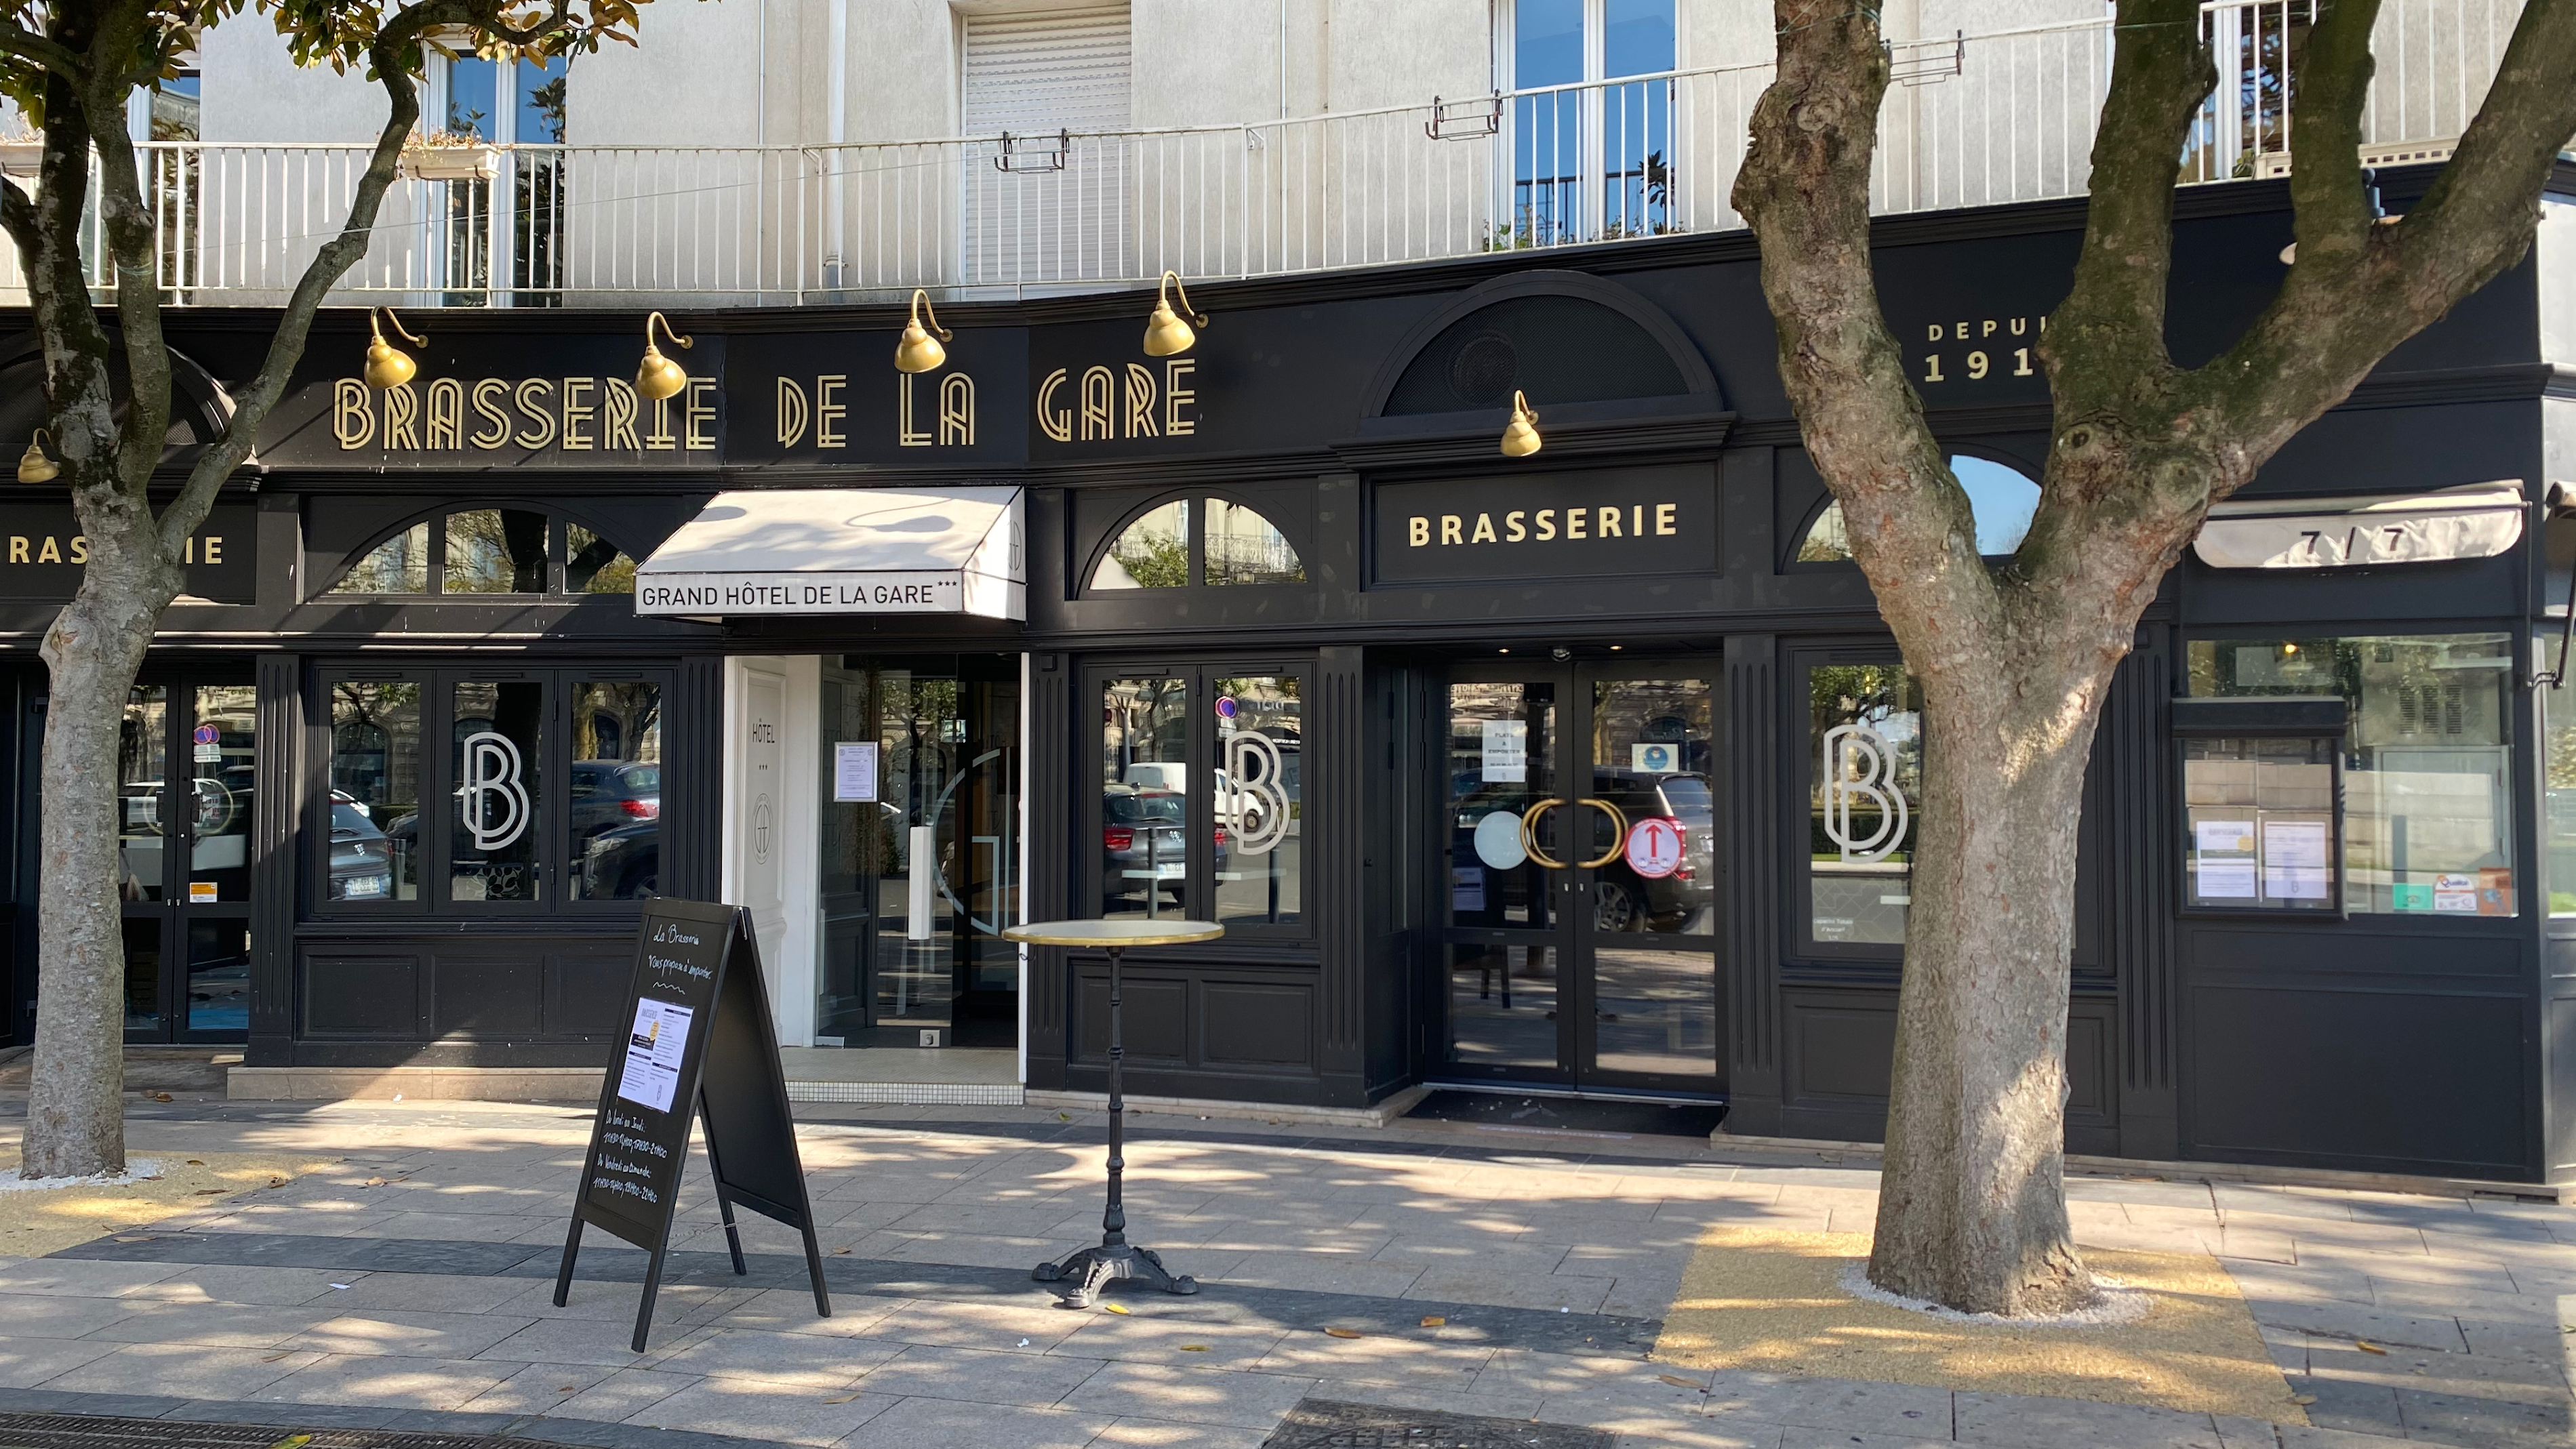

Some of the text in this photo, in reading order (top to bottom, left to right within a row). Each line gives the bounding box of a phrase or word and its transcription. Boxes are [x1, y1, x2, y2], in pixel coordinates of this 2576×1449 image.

[1928, 315, 2047, 342] DEPUI
[1925, 347, 2034, 382] 191
[334, 358, 1196, 451] BRASSERIE DE LA GARE
[1409, 502, 1677, 548] BRASSERIE
[643, 581, 933, 606] GRAND HÔTEL DE LA GARE
[752, 718, 775, 744] HÔTEL
